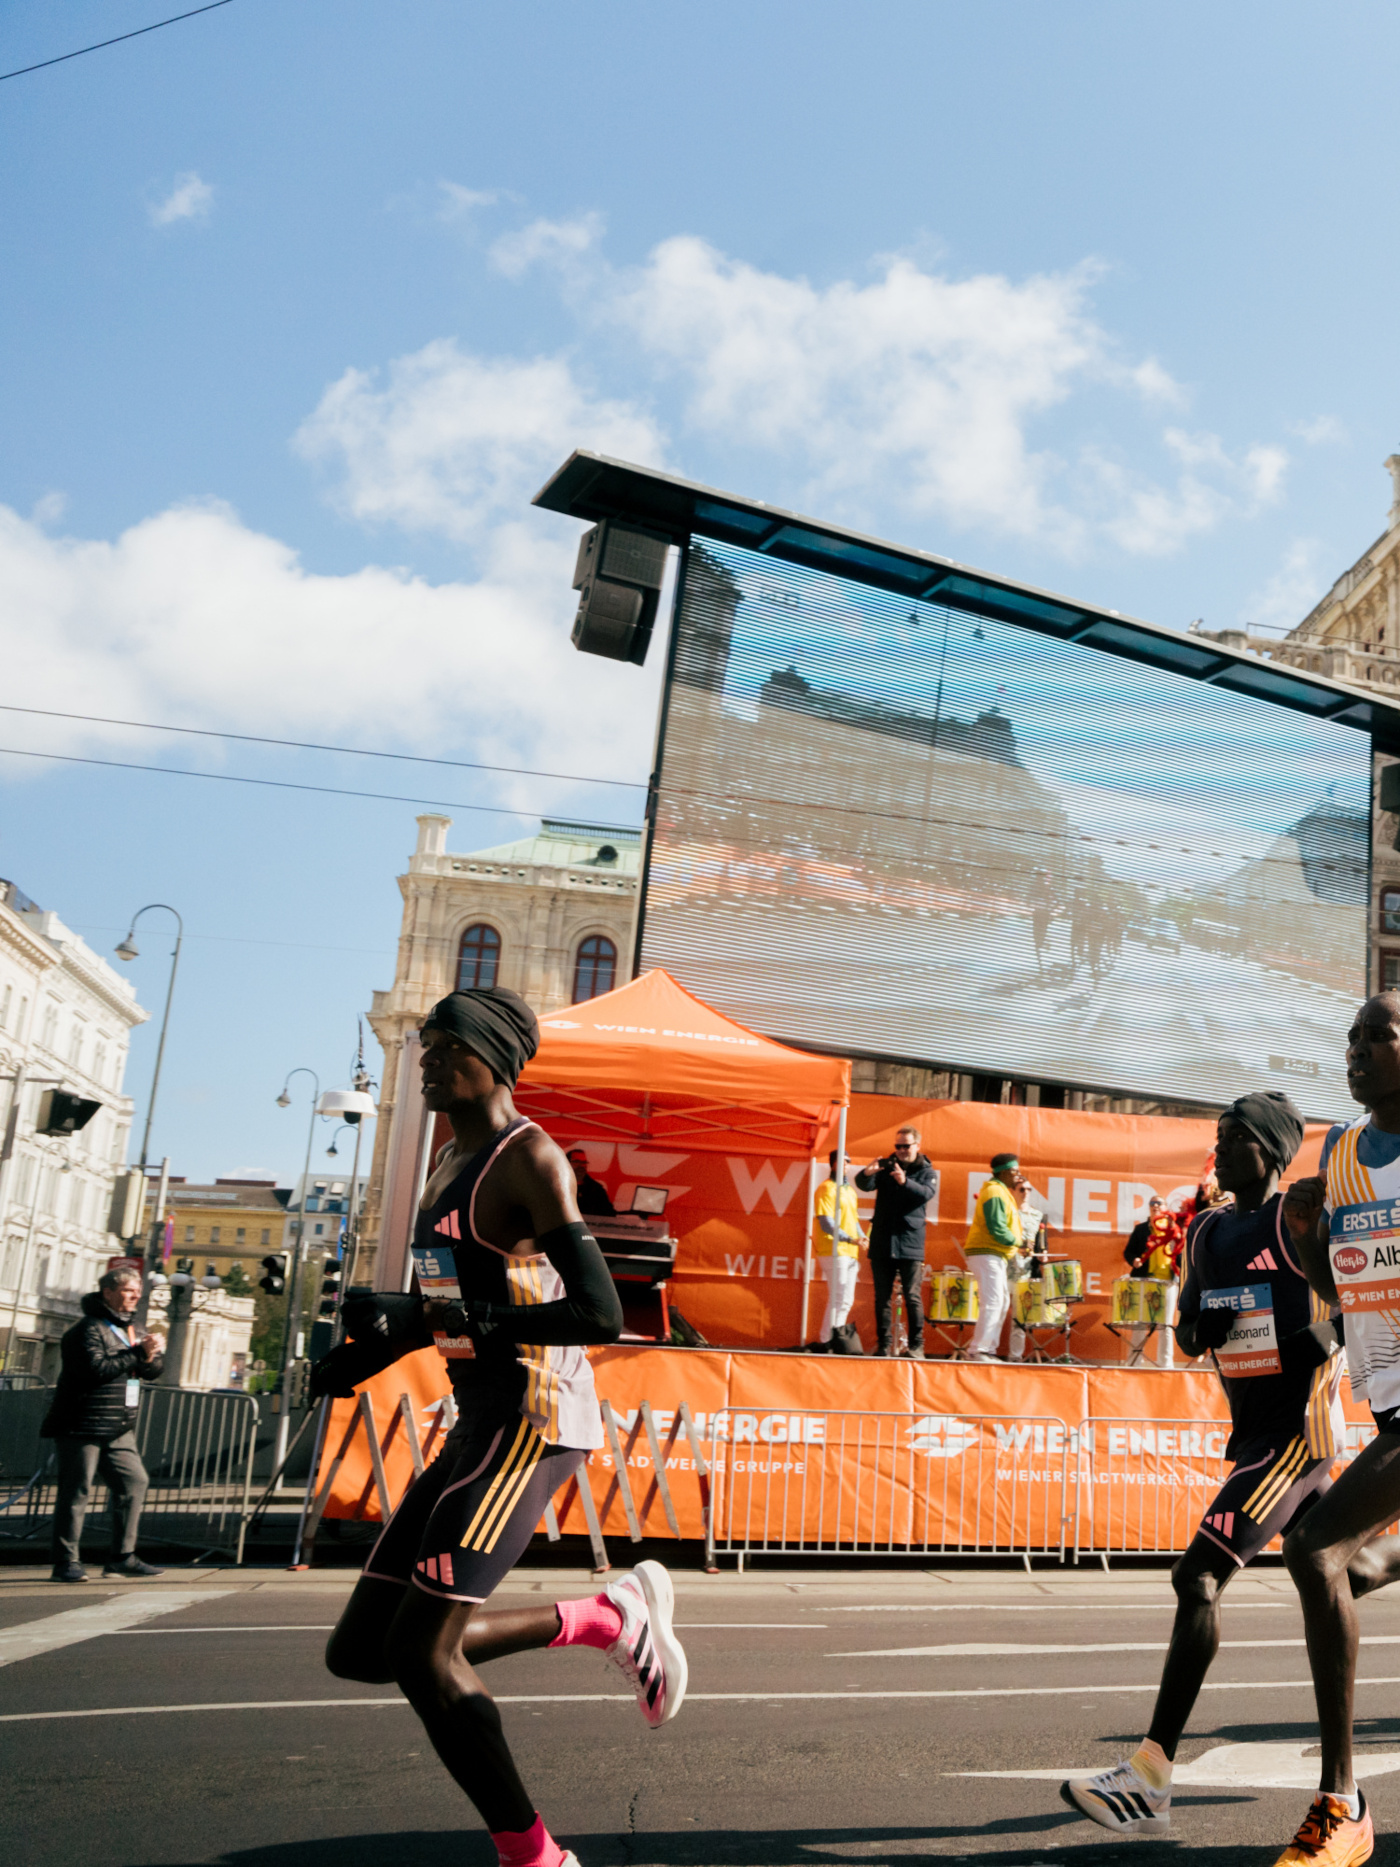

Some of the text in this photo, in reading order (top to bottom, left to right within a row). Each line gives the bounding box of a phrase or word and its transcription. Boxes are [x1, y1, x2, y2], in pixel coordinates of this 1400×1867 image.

[593, 1024, 759, 1046] WIEN ENERGIE
[1343, 1209, 1389, 1232] ERSTE
[1335, 1253, 1366, 1269] Hervis
[1207, 1295, 1240, 1310] ERSTE
[1357, 1290, 1385, 1302] WIEN
[1228, 1323, 1269, 1341] Leonard
[439, 1338, 472, 1348] ENERGIE
[1239, 1357, 1279, 1370] ENERGIE
[993, 1423, 1232, 1459] WIEN ENERG
[602, 1454, 726, 1473] SADWEKE
[733, 1460, 806, 1474] GRUPPE
[997, 1468, 1063, 1483] WIENER
[1069, 1471, 1177, 1487] STADTWERKE
